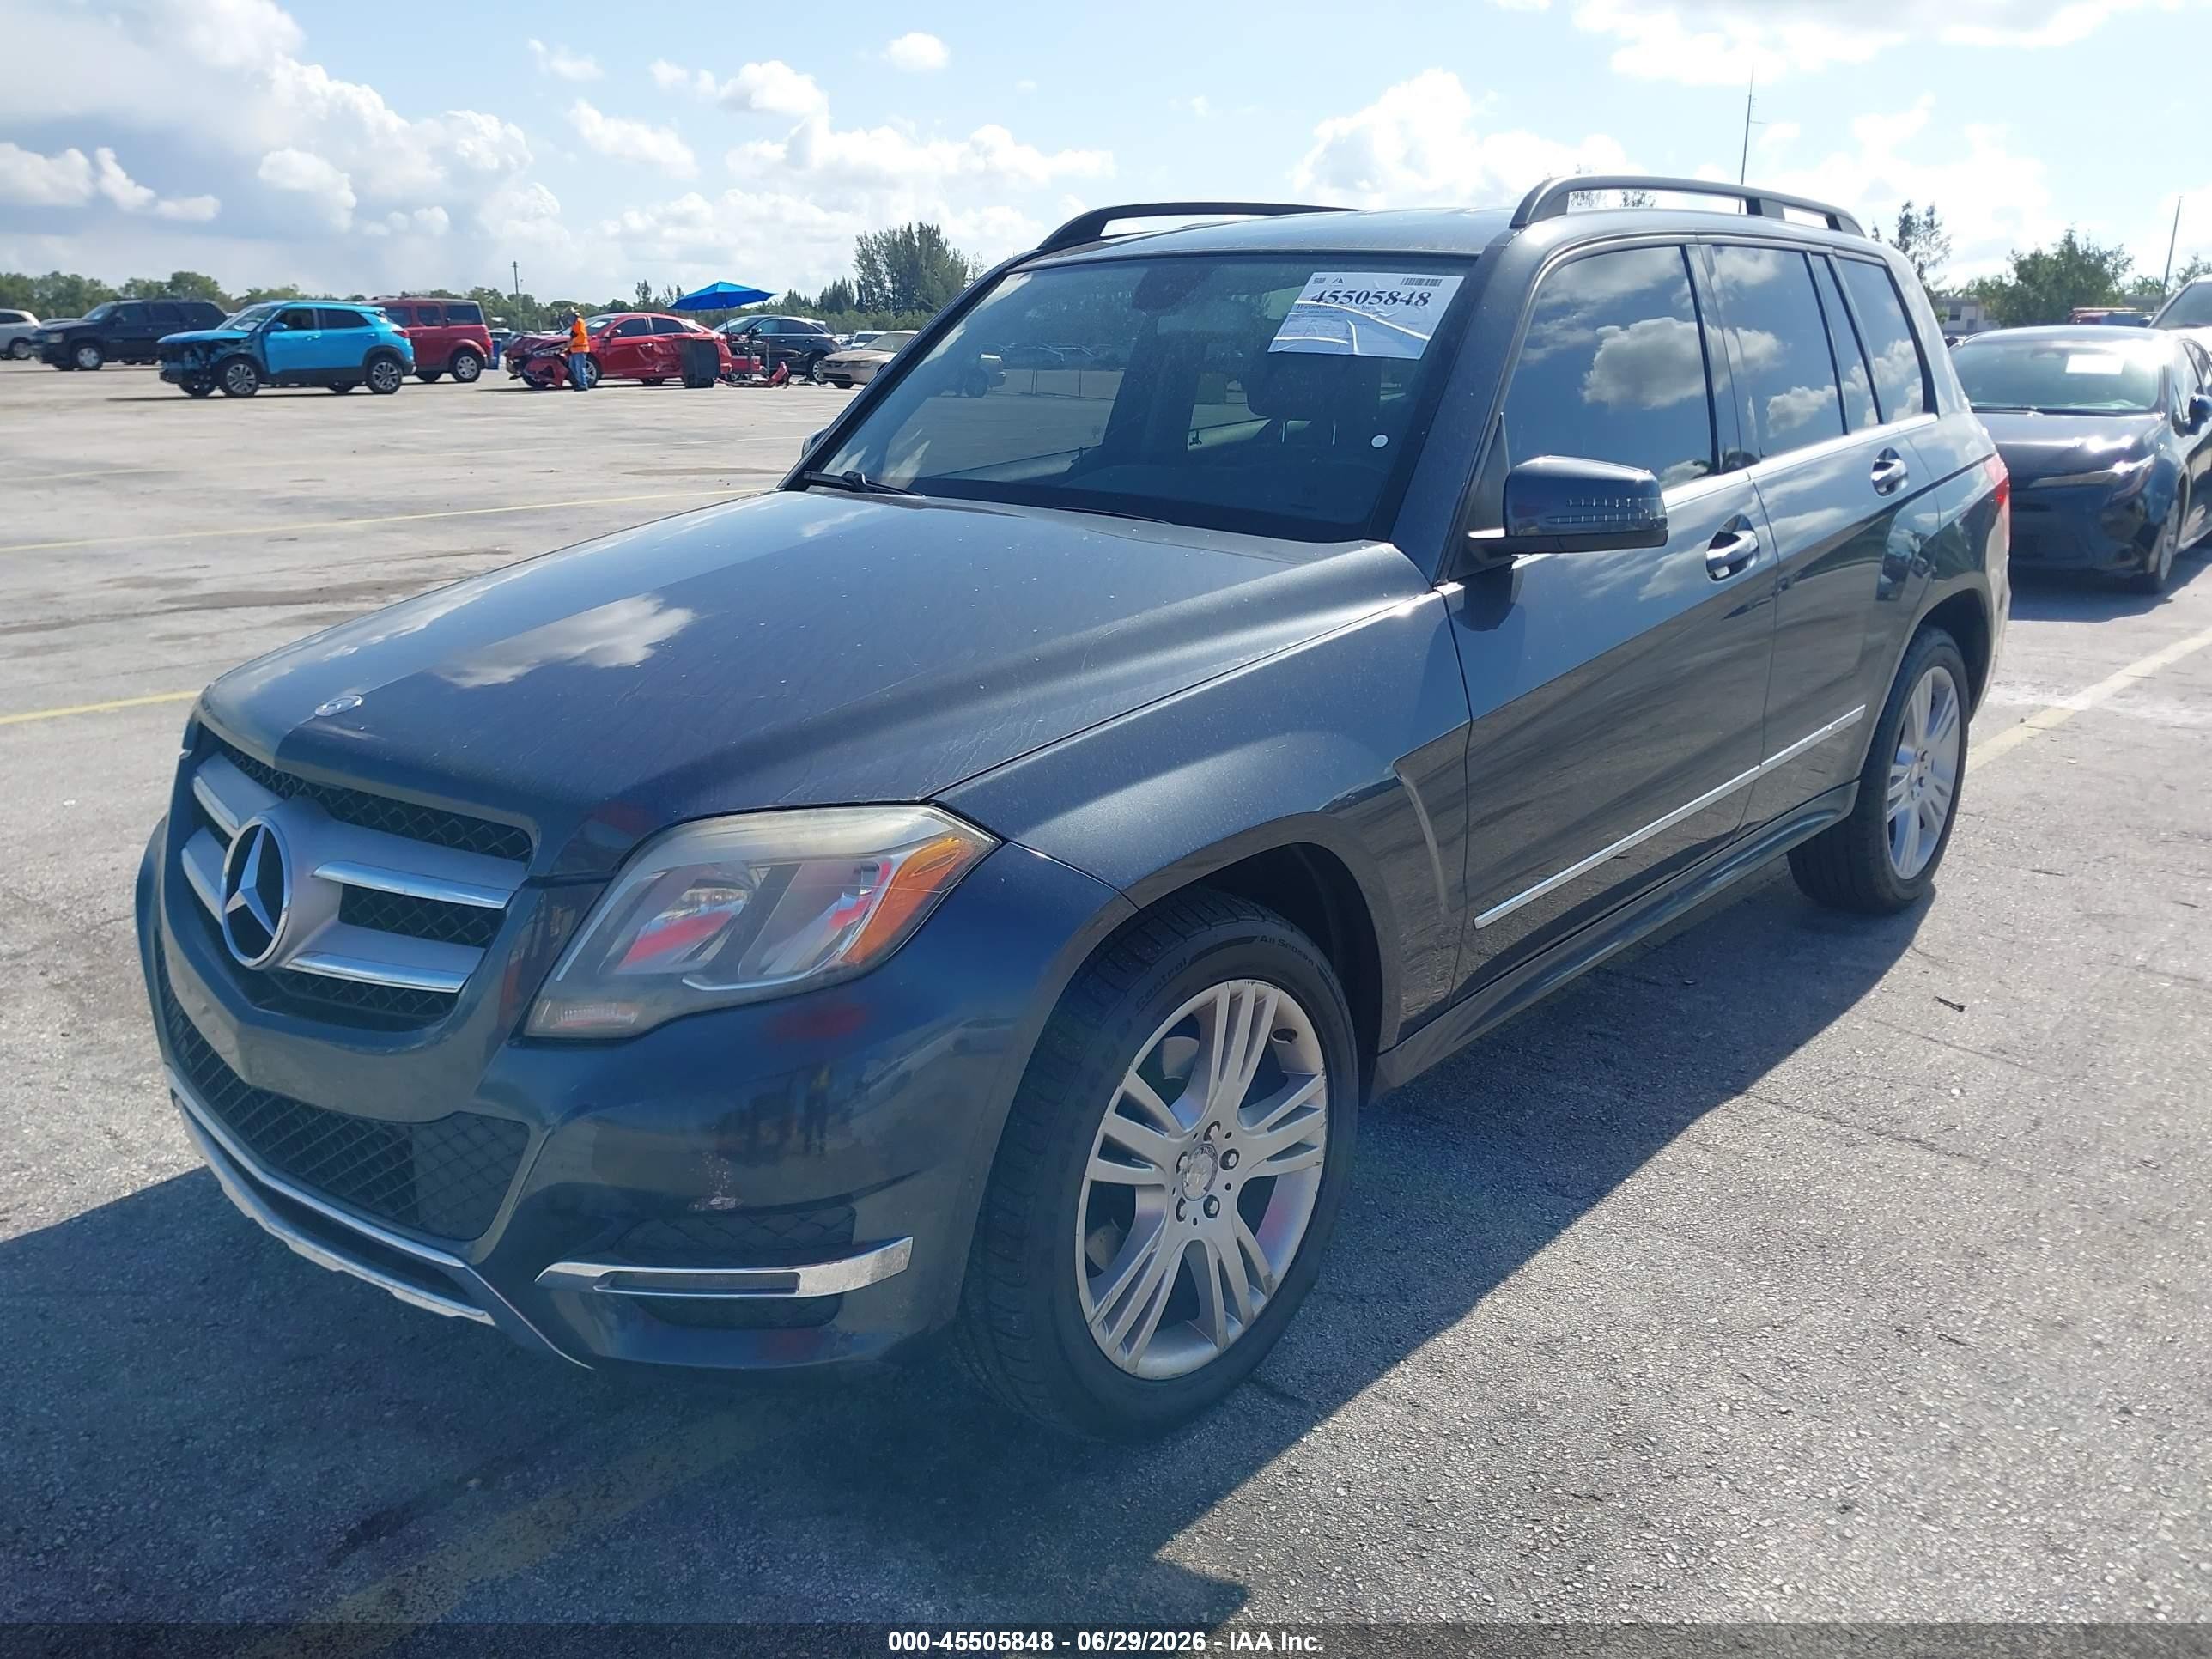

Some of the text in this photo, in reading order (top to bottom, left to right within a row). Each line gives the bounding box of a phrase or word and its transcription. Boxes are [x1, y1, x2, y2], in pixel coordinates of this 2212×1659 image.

[1310, 289, 1432, 307] 45505848
[1260, 934, 1314, 967] All Season
